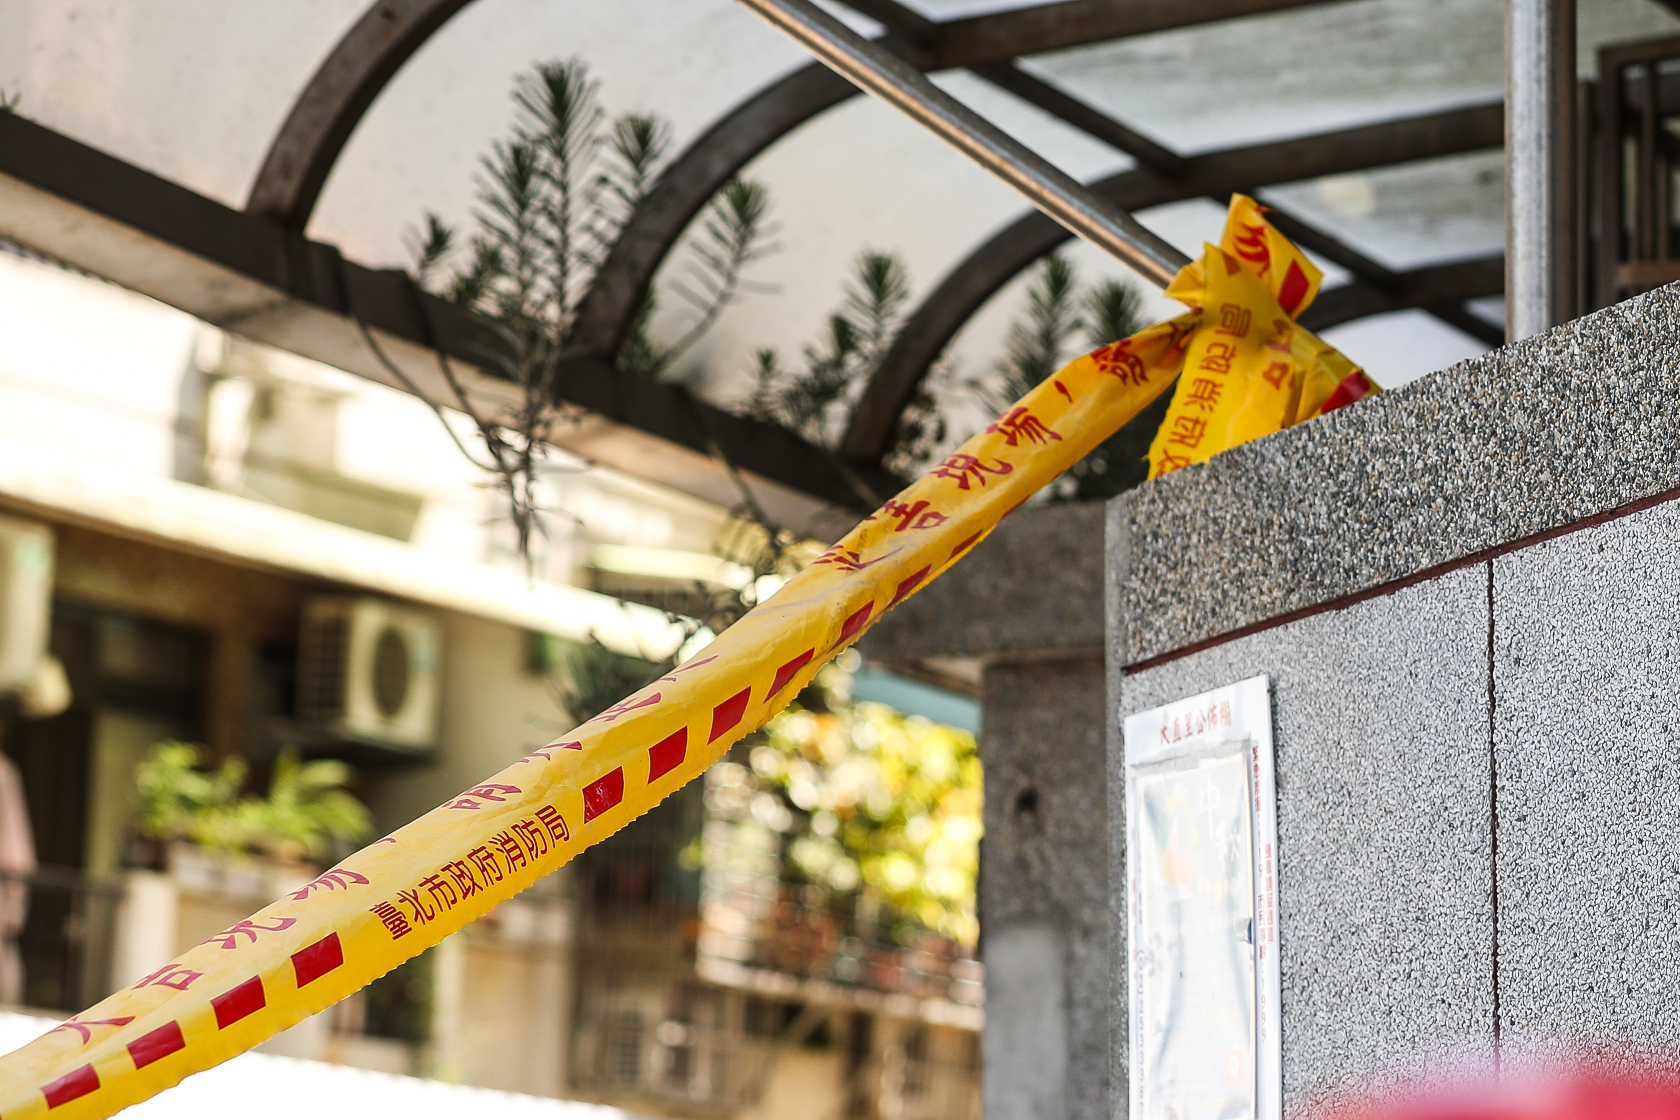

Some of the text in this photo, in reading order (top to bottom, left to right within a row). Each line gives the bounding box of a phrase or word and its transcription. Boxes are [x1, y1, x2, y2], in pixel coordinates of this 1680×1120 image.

[368, 804, 572, 941] 臺北市政府消防局
